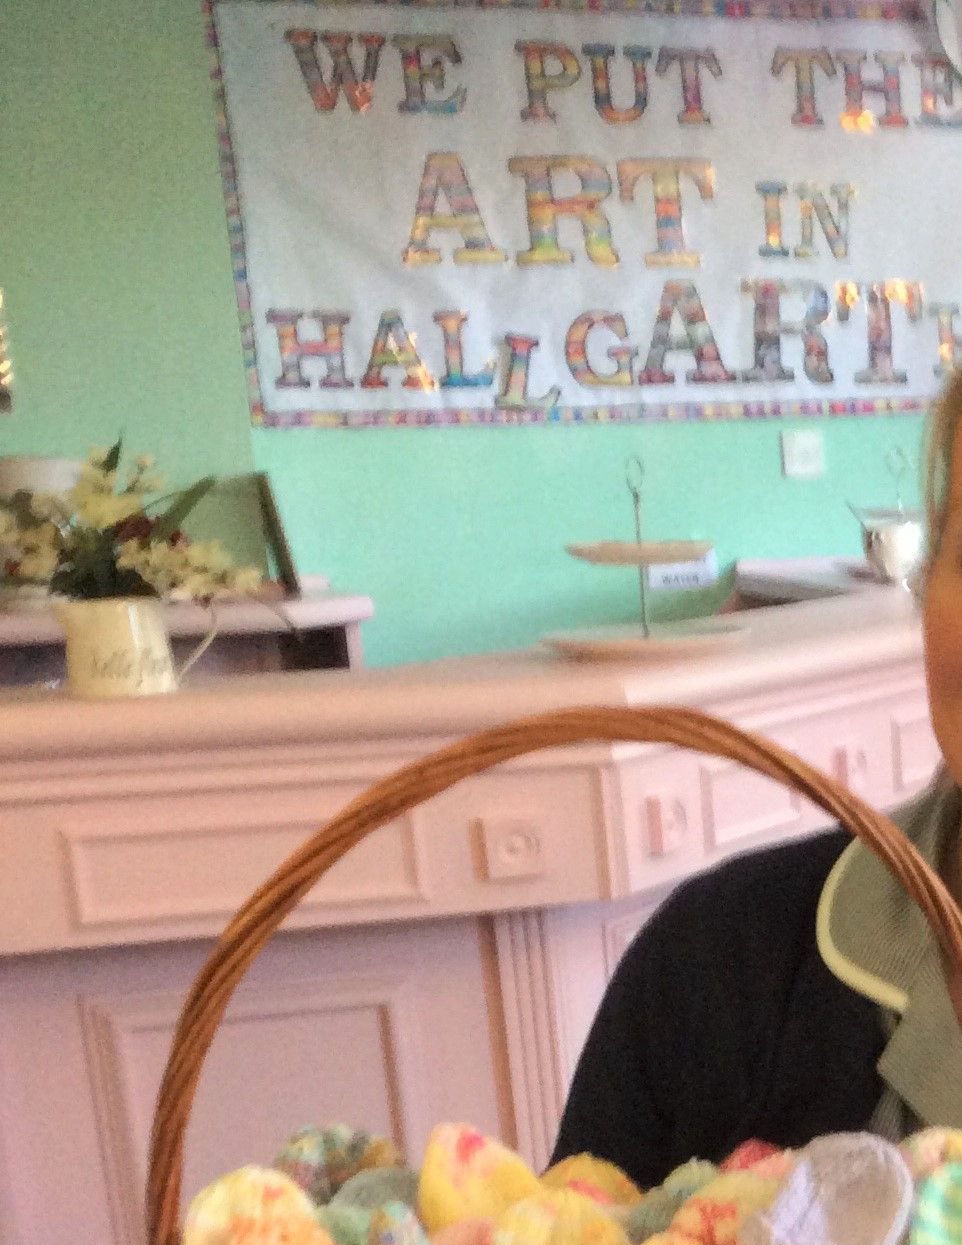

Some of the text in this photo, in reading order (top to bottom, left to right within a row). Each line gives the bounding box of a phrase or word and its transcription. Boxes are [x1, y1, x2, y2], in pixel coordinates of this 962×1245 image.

[284, 29, 467, 114] WE
[514, 39, 722, 125] PUT
[402, 151, 856, 269] ART IN
